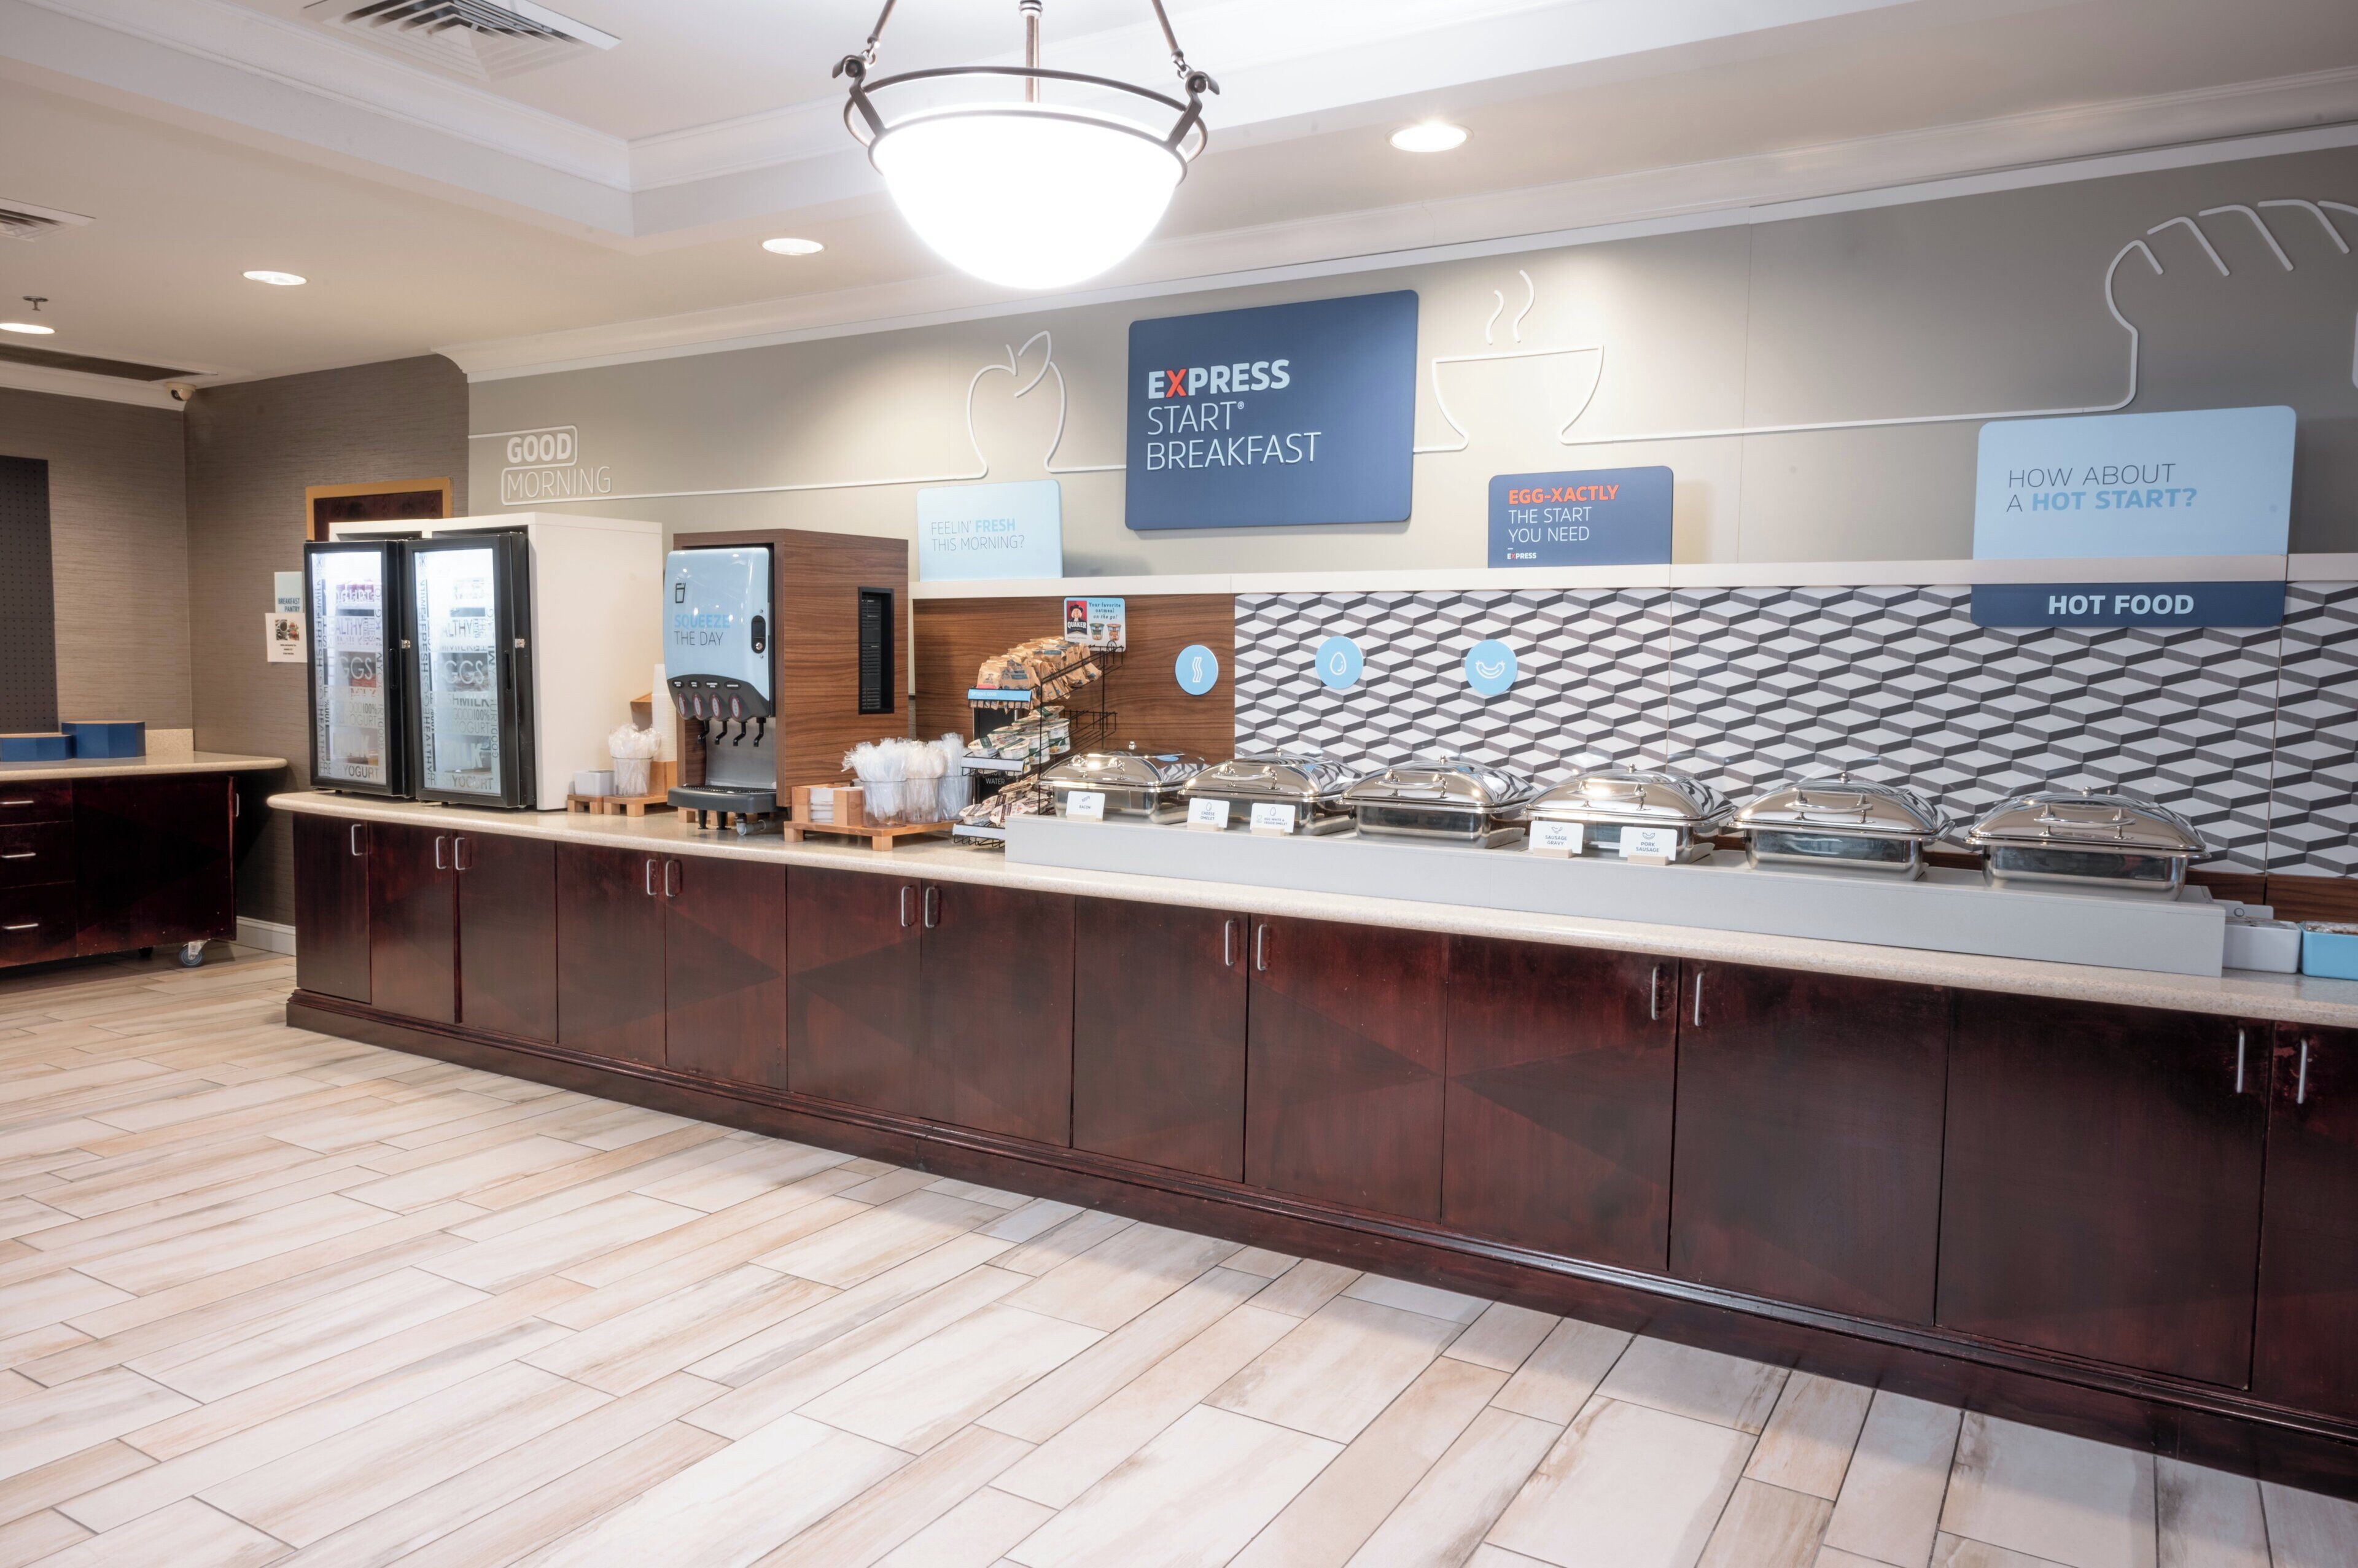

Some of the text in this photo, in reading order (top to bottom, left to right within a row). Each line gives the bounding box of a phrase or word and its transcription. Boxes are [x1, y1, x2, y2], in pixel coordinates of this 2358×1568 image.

[1148, 359, 1290, 399] EXPRESS
[507, 433, 572, 464] GOOD
[1147, 432, 1321, 470] BREAKFAST
[508, 466, 612, 499] MORNING
[2009, 464, 2176, 488] HOW ABOUT
[1509, 484, 1619, 505] EGG-XACTLY
[2006, 487, 2197, 512] A HOT START?
[1508, 506, 1592, 524] THE START
[931, 518, 1015, 535] FEELIN' FRESH
[1508, 526, 1590, 543] YOU NEED
[932, 535, 1025, 551] THIS MORNING?
[2049, 594, 2194, 615] HOT FOOD
[674, 614, 731, 628] SQUEEZE
[674, 631, 723, 645] THE DAY
[363, 702, 378, 715] 100%
[473, 708, 490, 721] 100%
[491, 728, 499, 758] GOOD
[343, 764, 379, 780] YOGURT
